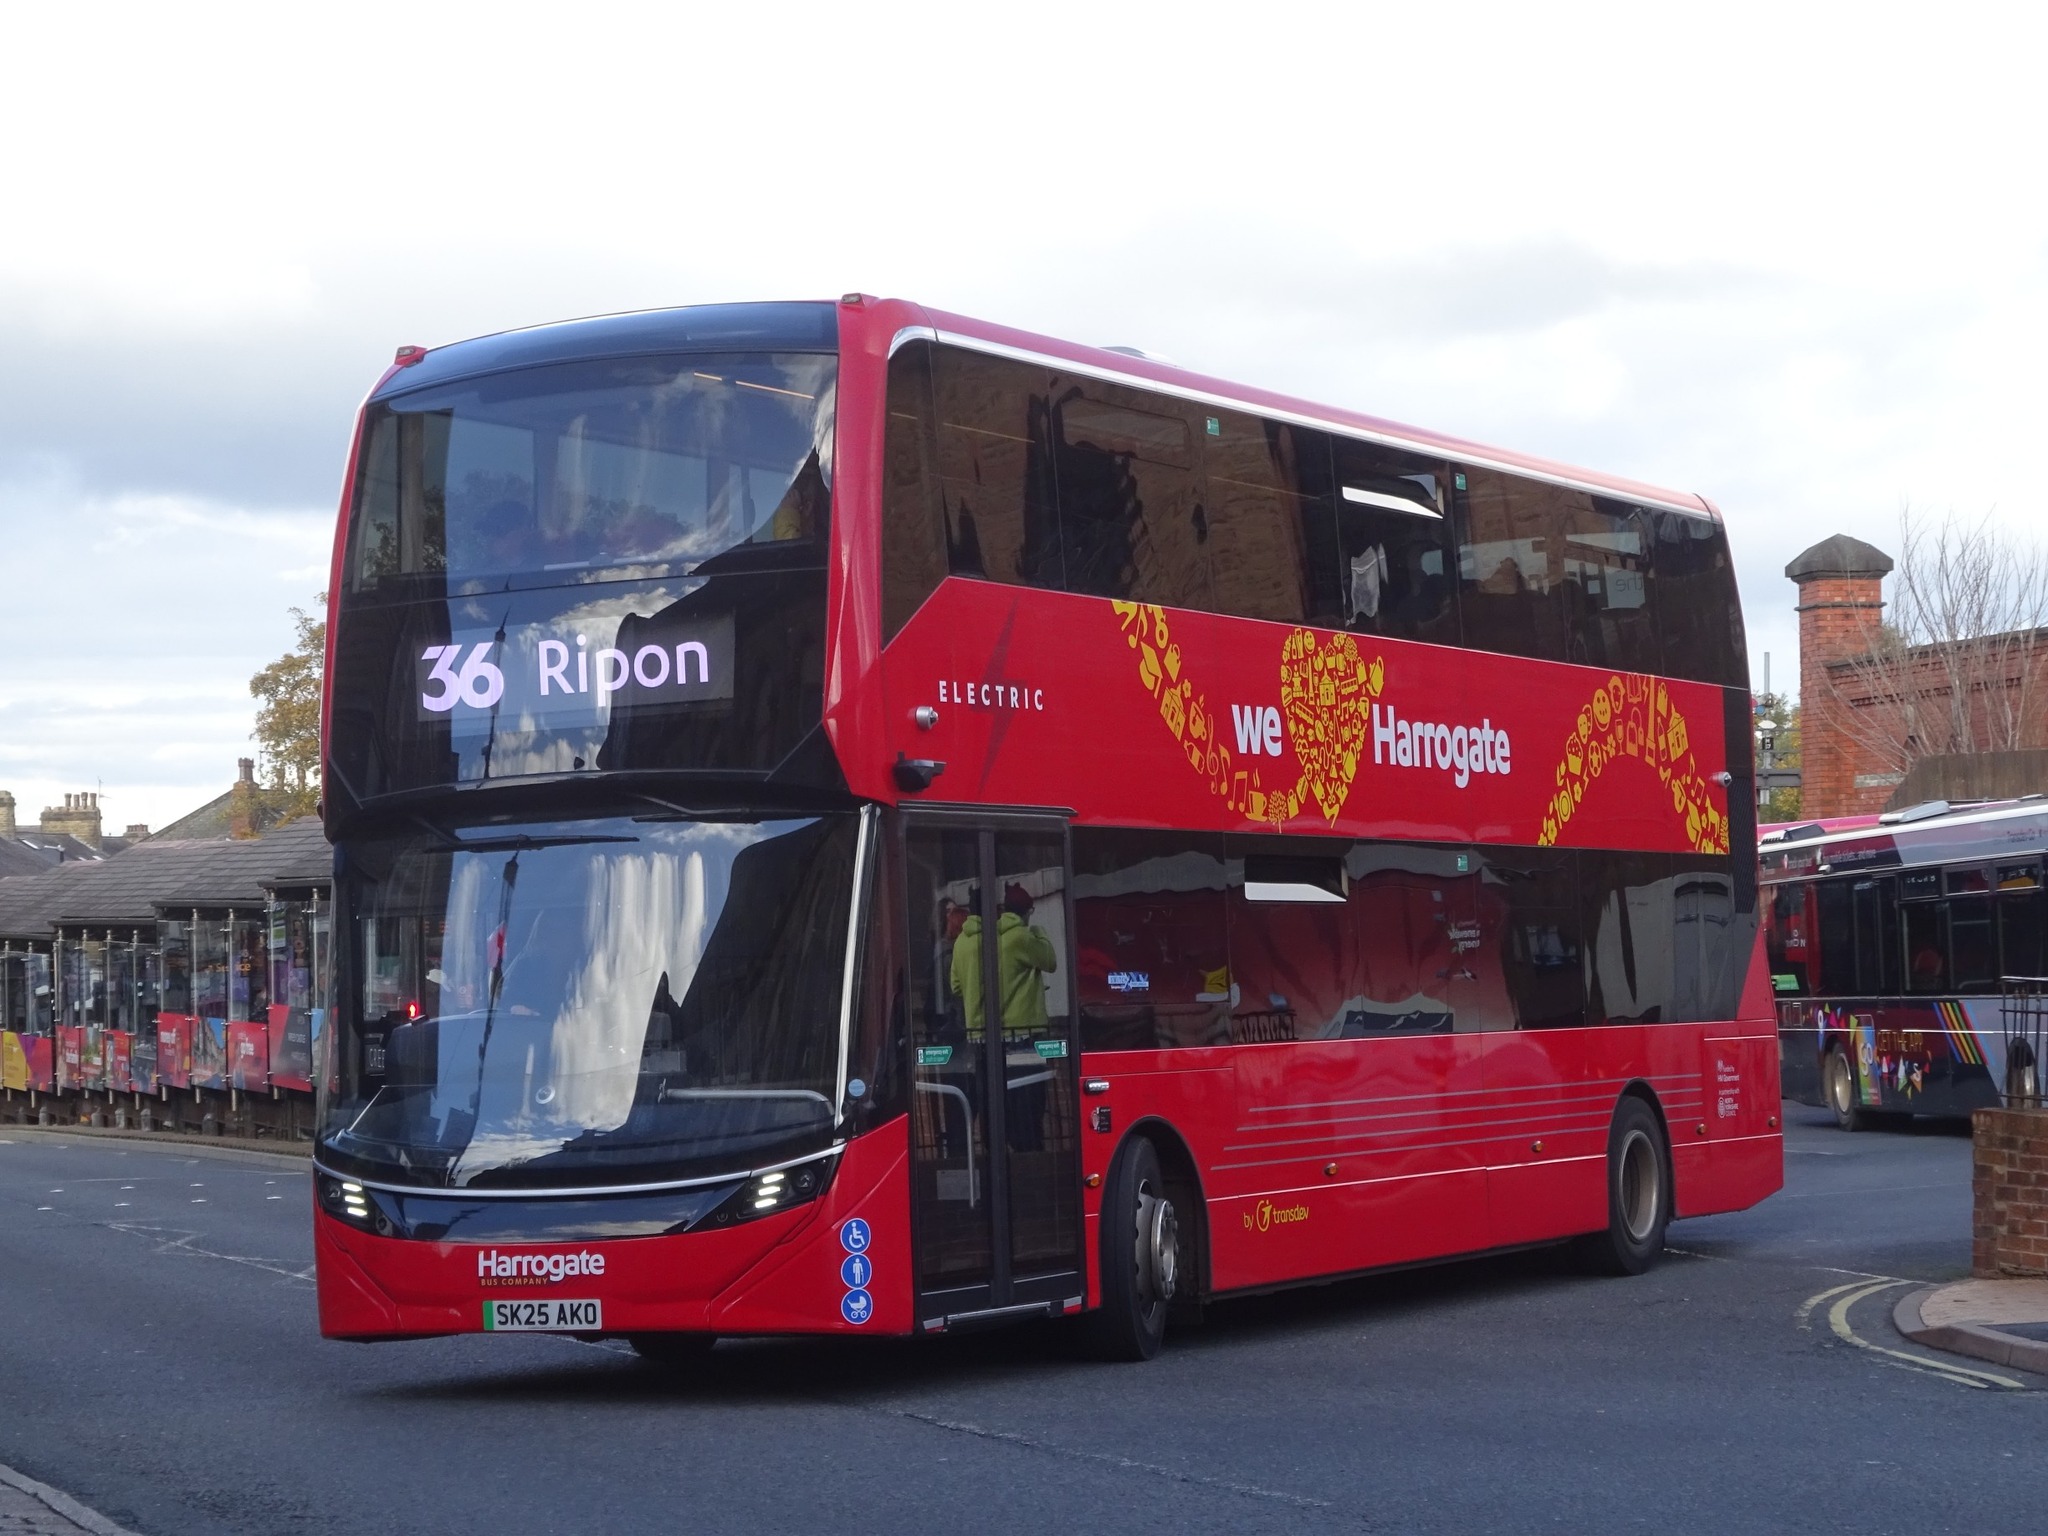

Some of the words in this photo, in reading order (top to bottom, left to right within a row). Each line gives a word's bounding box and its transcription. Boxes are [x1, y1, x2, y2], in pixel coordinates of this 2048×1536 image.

[421, 641, 504, 712] 36
[538, 633, 709, 708] Ripon
[938, 680, 1044, 711] ELECTRIC
[1372, 703, 1511, 789] Harrogate
[1243, 1212, 1254, 1231] by
[1273, 1204, 1309, 1224] transdev
[478, 1249, 605, 1282] Harrogate
[481, 1278, 498, 1286] BUS
[501, 1277, 549, 1286] COMPANY
[496, 1303, 549, 1326] SK25
[556, 1303, 597, 1325] AKO
